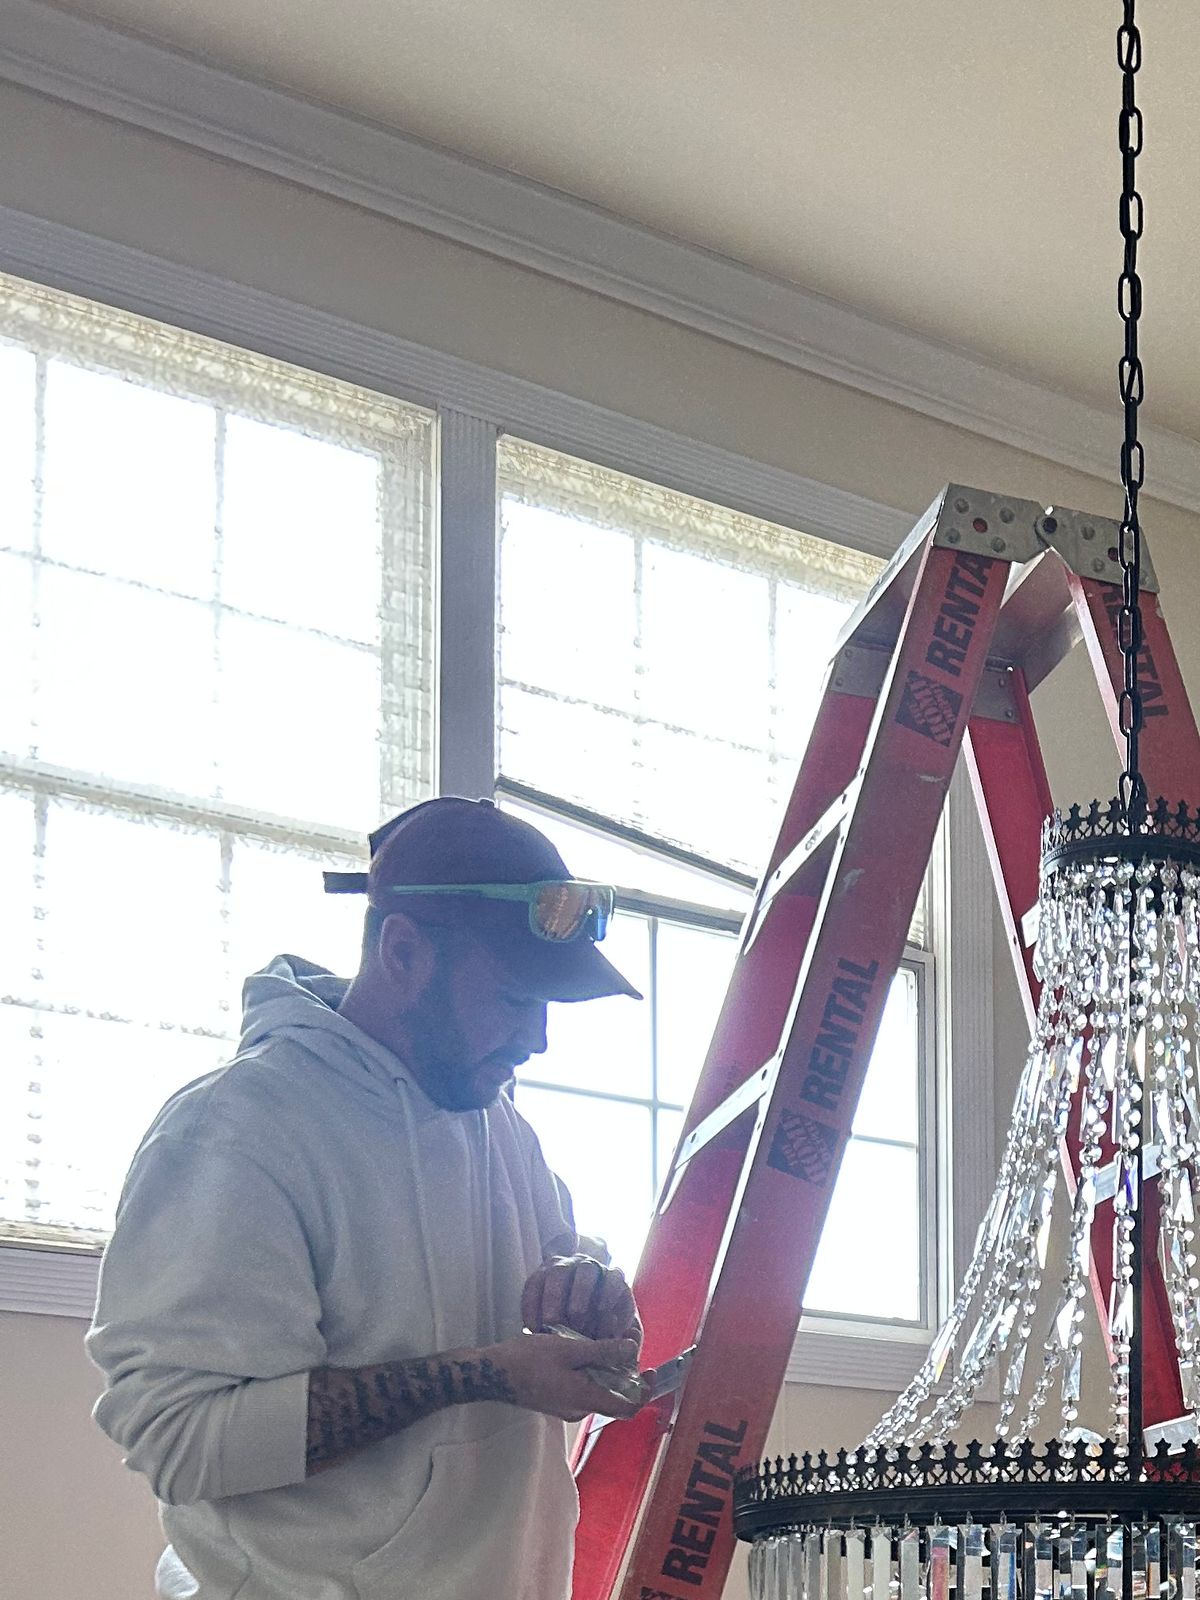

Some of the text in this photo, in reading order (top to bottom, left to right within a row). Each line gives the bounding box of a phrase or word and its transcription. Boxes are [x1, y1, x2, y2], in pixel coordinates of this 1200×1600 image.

[925, 550, 993, 677] RENTA
[800, 957, 880, 1112] RENTAL
[661, 1420, 748, 1586] RENTAL
